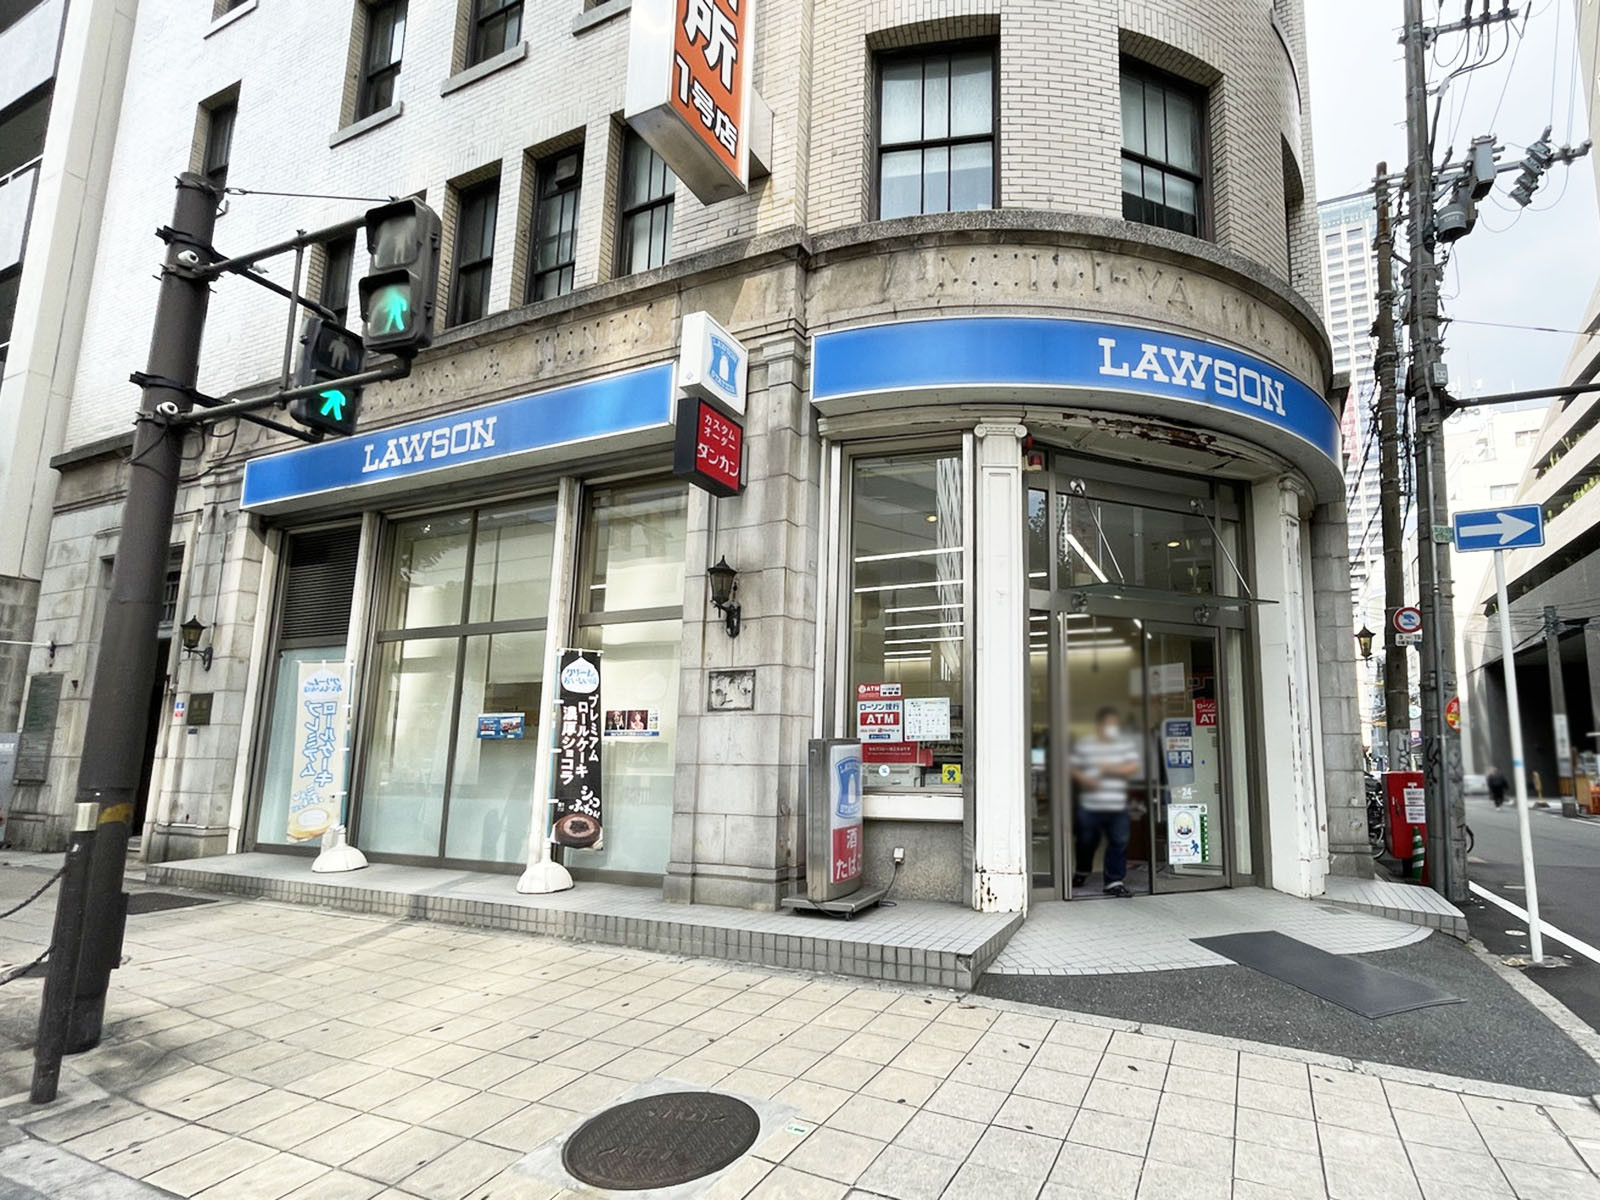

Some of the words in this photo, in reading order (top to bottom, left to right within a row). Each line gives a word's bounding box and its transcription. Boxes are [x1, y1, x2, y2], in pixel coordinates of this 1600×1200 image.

[683, 0, 739, 95] 所
[675, 51, 738, 158] 1号店
[1098, 337, 1286, 416] LAWSON
[361, 415, 498, 474] LAWSON
[703, 425, 736, 450] オーダー
[704, 413, 736, 442] カスタム
[696, 442, 739, 478] ダンカン
[588, 694, 600, 763] プレミアム
[860, 703, 900, 711] ローソン銀行
[866, 713, 894, 724] ATM
[559, 705, 578, 786] 濃厚ショコラ
[575, 701, 589, 779] ロールケーキ
[846, 829, 858, 849] 酒
